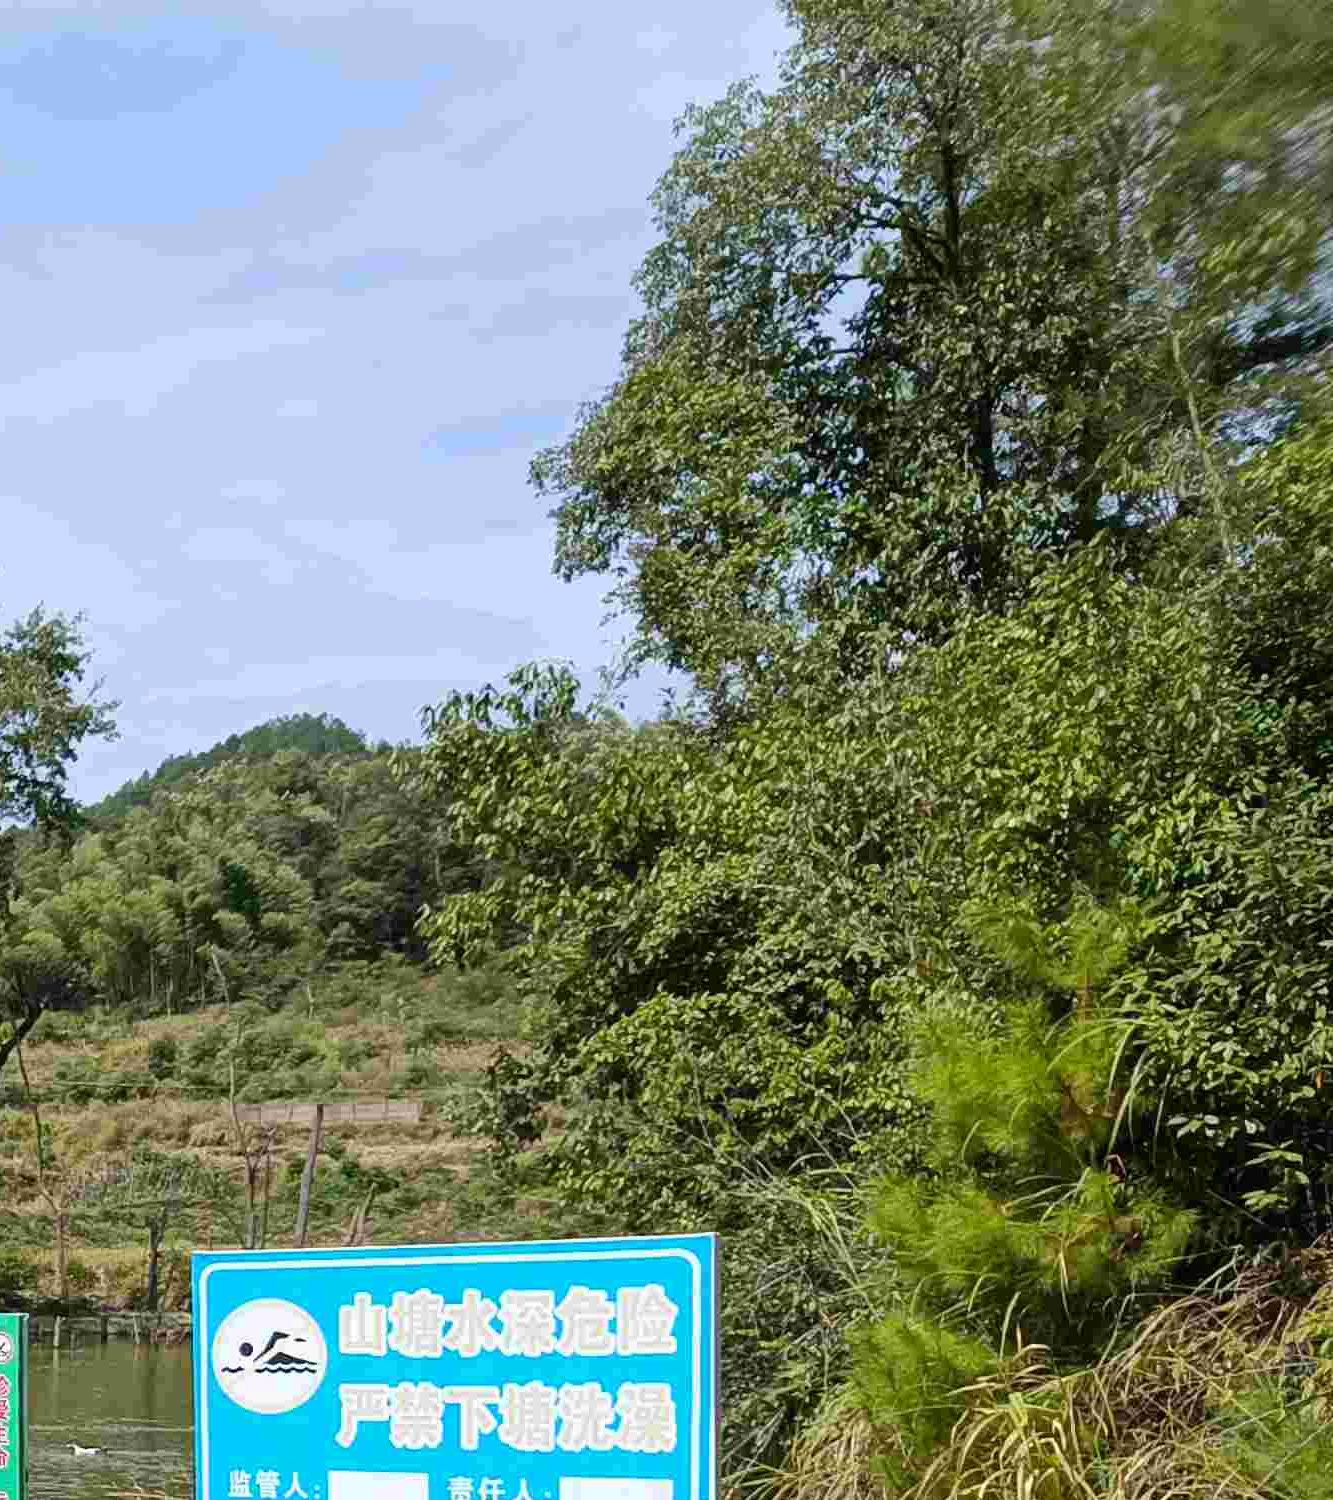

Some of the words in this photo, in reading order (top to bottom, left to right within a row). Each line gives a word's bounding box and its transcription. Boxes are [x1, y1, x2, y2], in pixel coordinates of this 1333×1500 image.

[339, 1285, 678, 1357] 山塘水深危险
[336, 1381, 677, 1453] 严禁下塘洗澡
